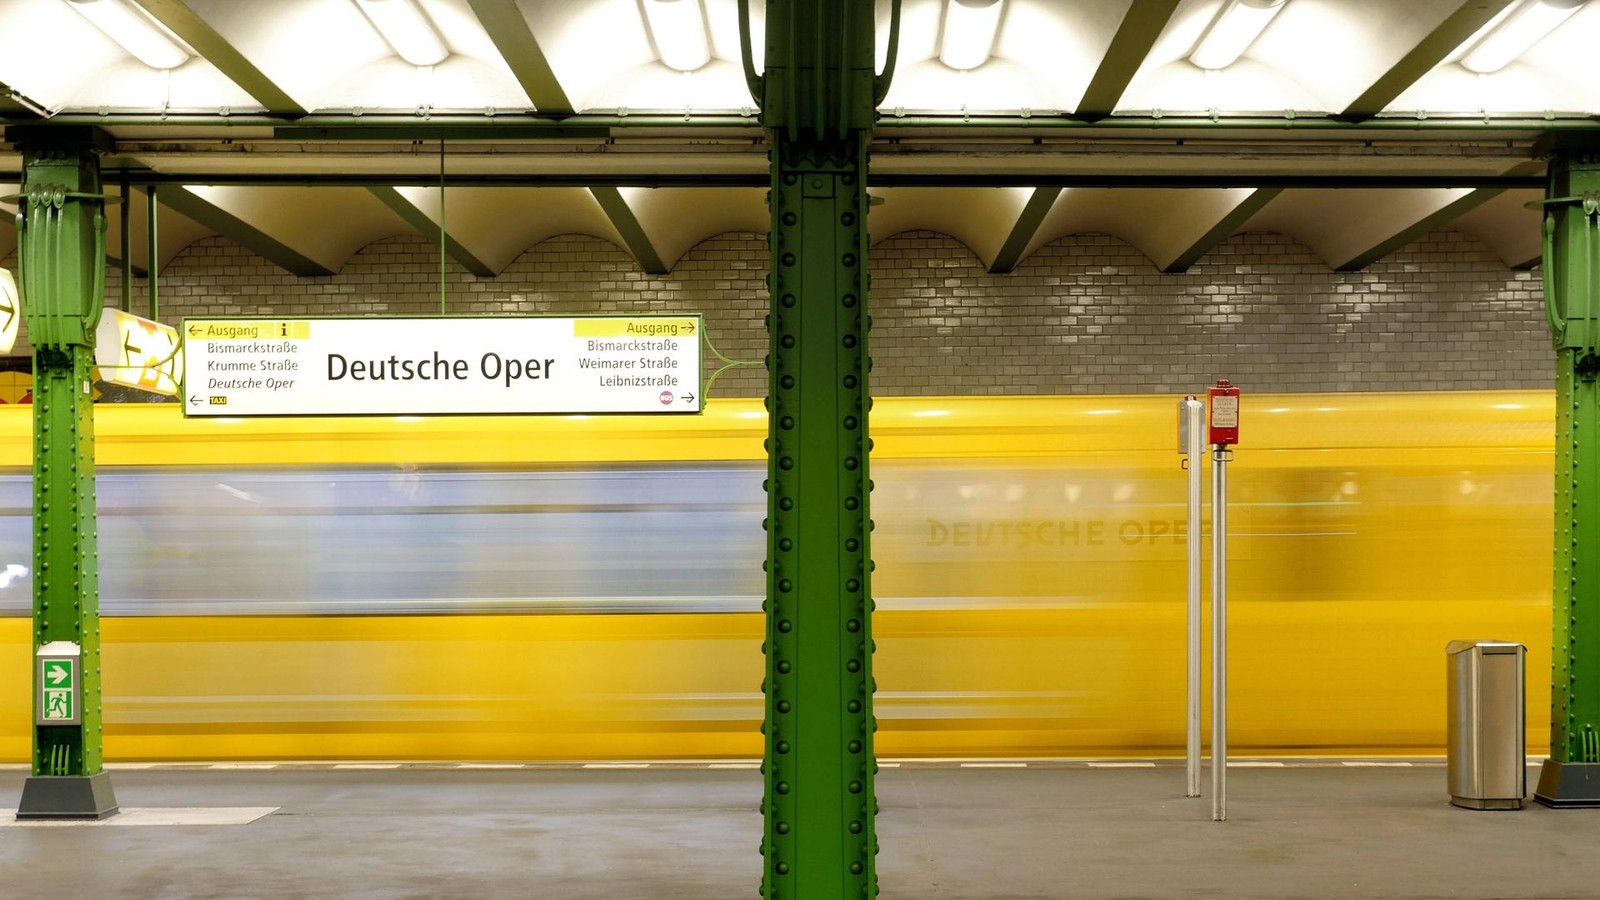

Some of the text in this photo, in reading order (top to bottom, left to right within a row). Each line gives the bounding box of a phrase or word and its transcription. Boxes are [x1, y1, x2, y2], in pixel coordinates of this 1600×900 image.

[207, 325, 258, 338] Ausgang
[626, 322, 678, 336] Ausgang
[207, 341, 298, 353] Bismarckstraße
[587, 338, 678, 351] Bismarckstraße
[207, 359, 299, 371] Krumme Straße
[328, 351, 555, 387] Deutsche Oper
[578, 356, 678, 369] Weimarer Straße
[208, 377, 295, 391] Deutsche Oper
[599, 374, 678, 387] Leibnizstraße
[209, 396, 227, 405] TAXI
[926, 517, 1104, 549] DEUTSCHE
